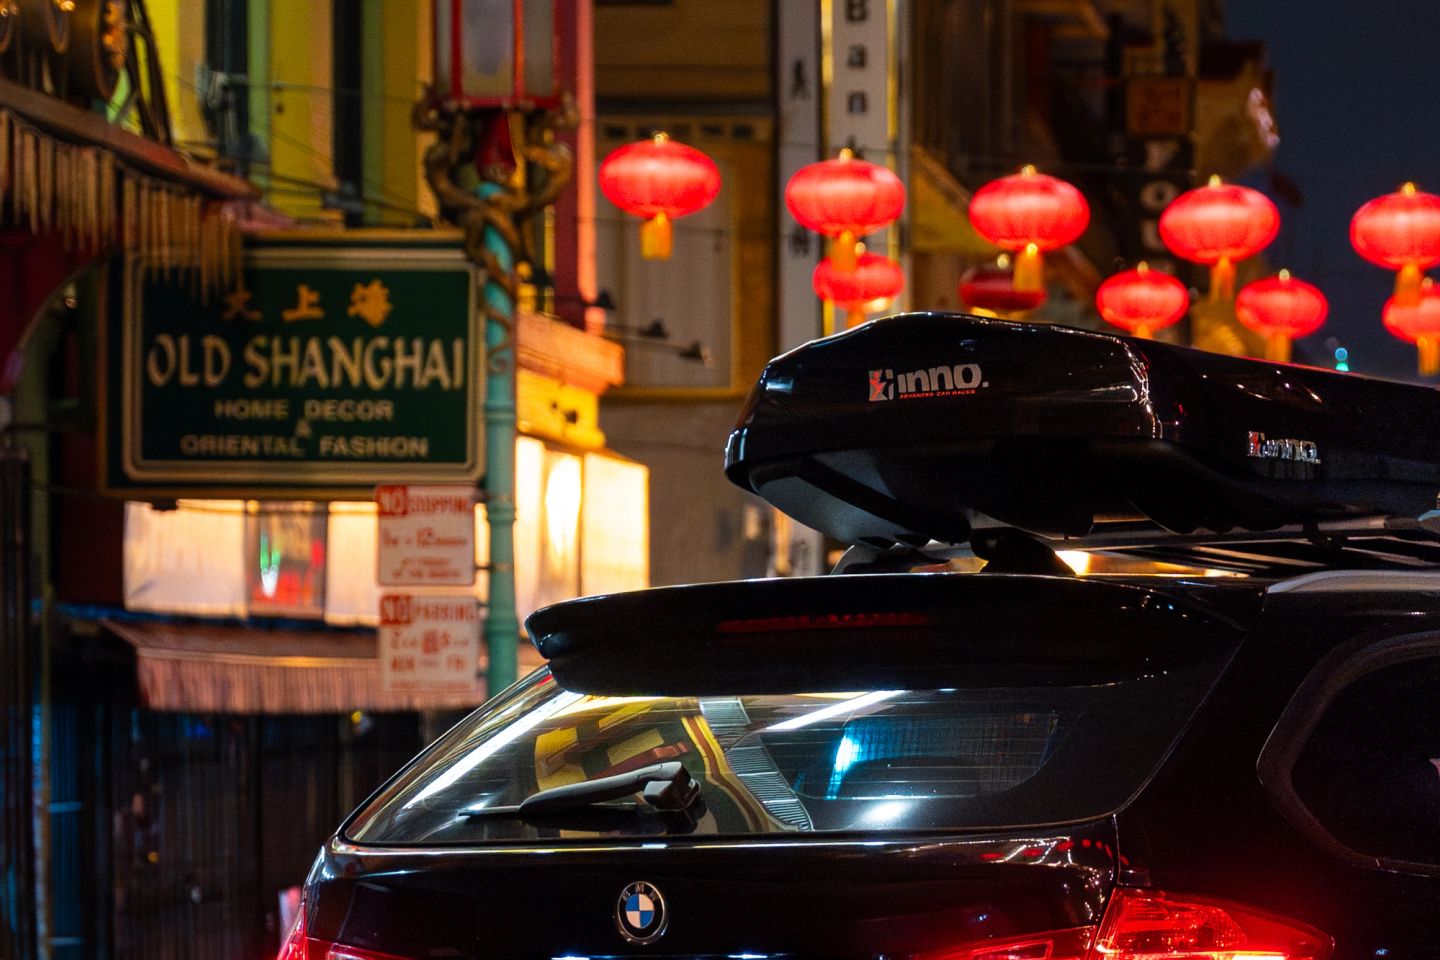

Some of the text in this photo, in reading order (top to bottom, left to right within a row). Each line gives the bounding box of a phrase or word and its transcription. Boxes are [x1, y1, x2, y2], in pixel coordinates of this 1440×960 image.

[147, 333, 466, 391] OLD SHANGHAI
[214, 399, 395, 422] HOME DECOR
[178, 435, 430, 458] ORIENTAL FASHION
